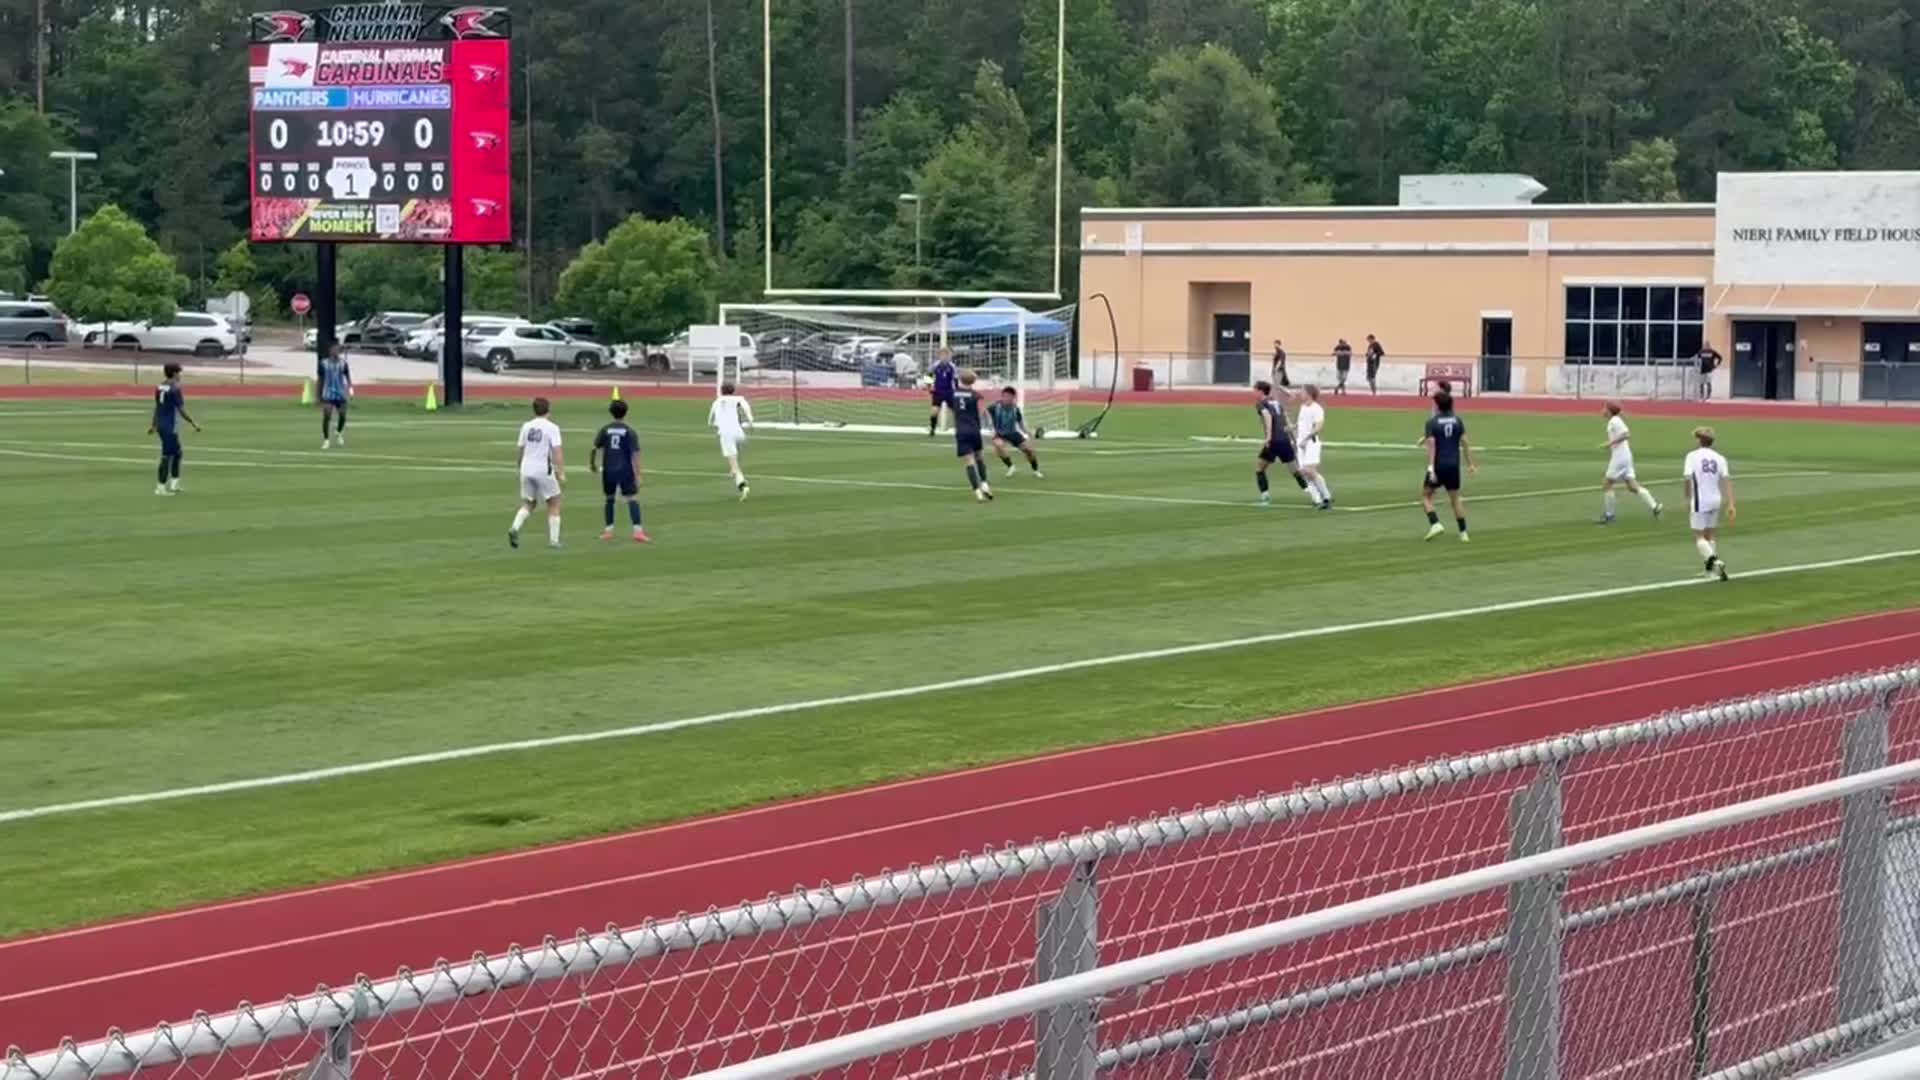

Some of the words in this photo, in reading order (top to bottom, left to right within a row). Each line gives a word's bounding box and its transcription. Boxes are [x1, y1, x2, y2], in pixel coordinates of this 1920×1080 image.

[330, 5, 424, 22] CARDINAL
[328, 24, 419, 41] NEWMAN
[318, 62, 442, 81] CARDINALS
[255, 89, 329, 106] PANTHERS
[353, 88, 449, 105] HURRICANES
[270, 118, 288, 149] 0
[317, 120, 385, 147] 10:59
[414, 117, 434, 149] 0
[261, 173, 272, 191] 0
[284, 173, 296, 191] 0
[308, 173, 319, 191] 0
[344, 173, 359, 196] 1
[383, 173, 394, 191] 0
[407, 173, 419, 191] 0
[432, 173, 444, 191] 0
[309, 219, 374, 233] MOMENT
[1733, 228, 1772, 242] NIERI
[1776, 227, 1830, 242] FAMILY
[1834, 228, 1877, 242] FIELD
